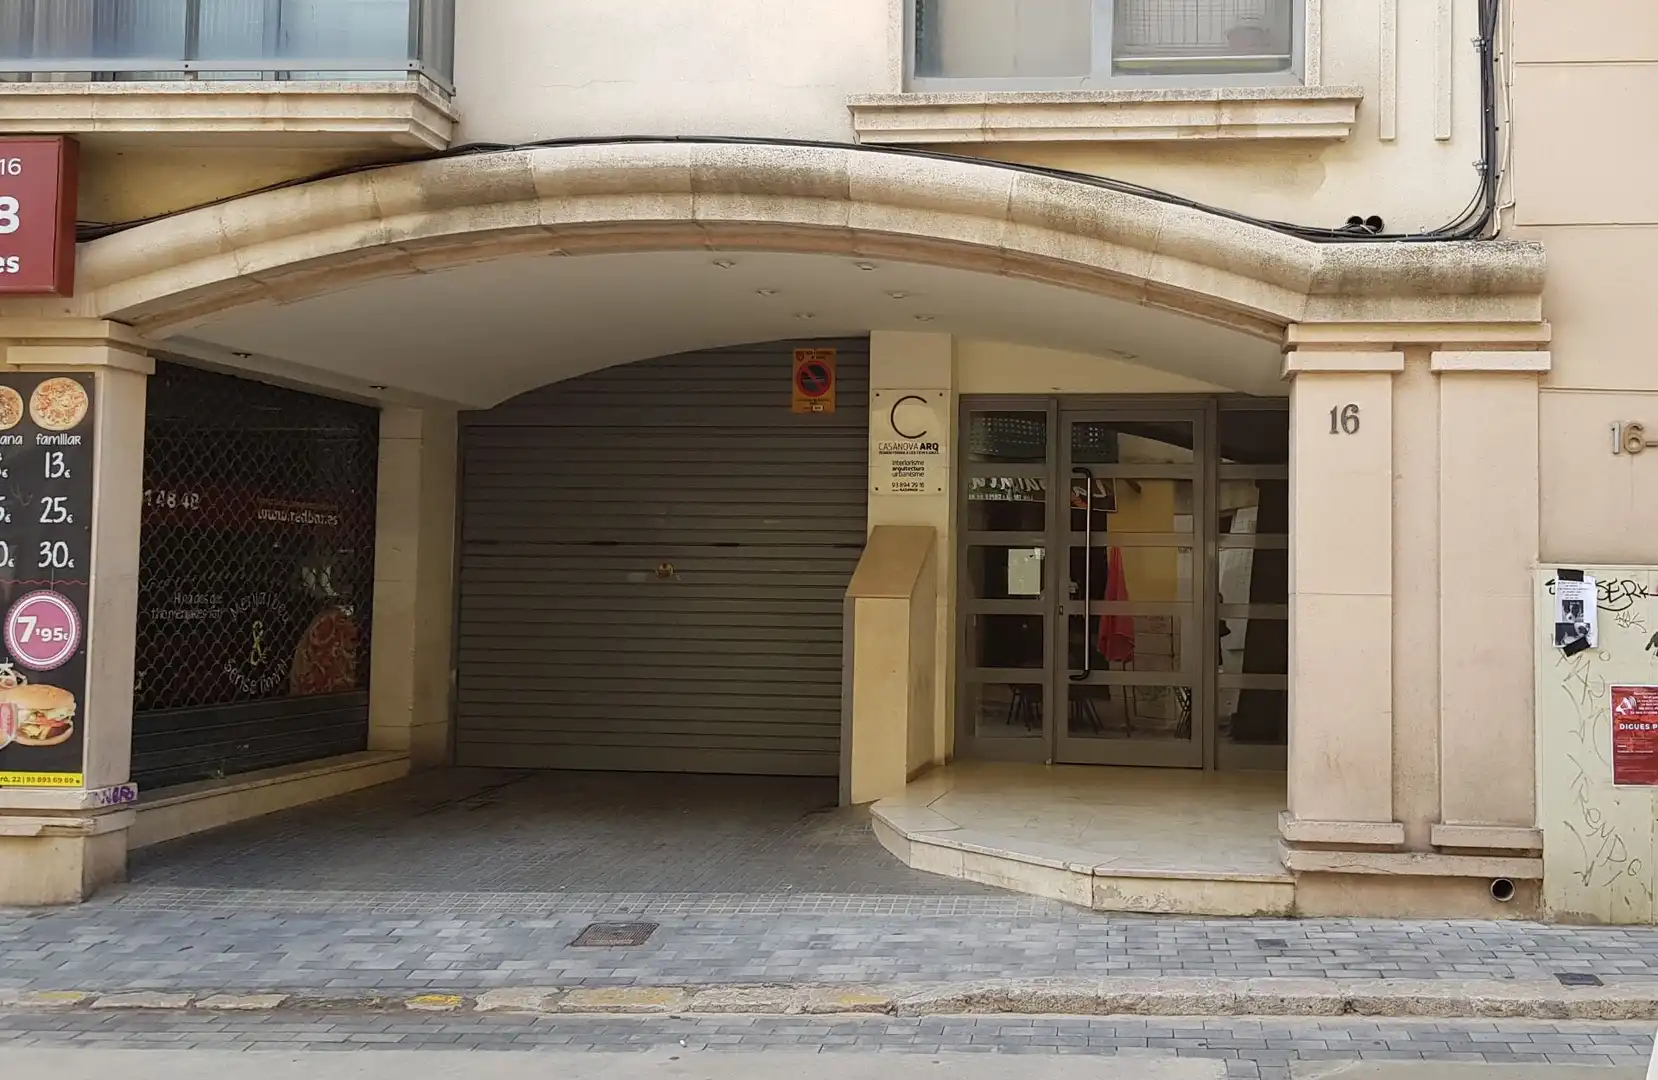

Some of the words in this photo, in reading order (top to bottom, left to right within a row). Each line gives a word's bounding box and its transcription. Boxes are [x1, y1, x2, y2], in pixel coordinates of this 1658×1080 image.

[1328, 403, 1360, 434] 16
[878, 442, 919, 451] CASANOVA
[920, 442, 939, 452] ARQ
[1619, 723, 1650, 731] DIGUES
